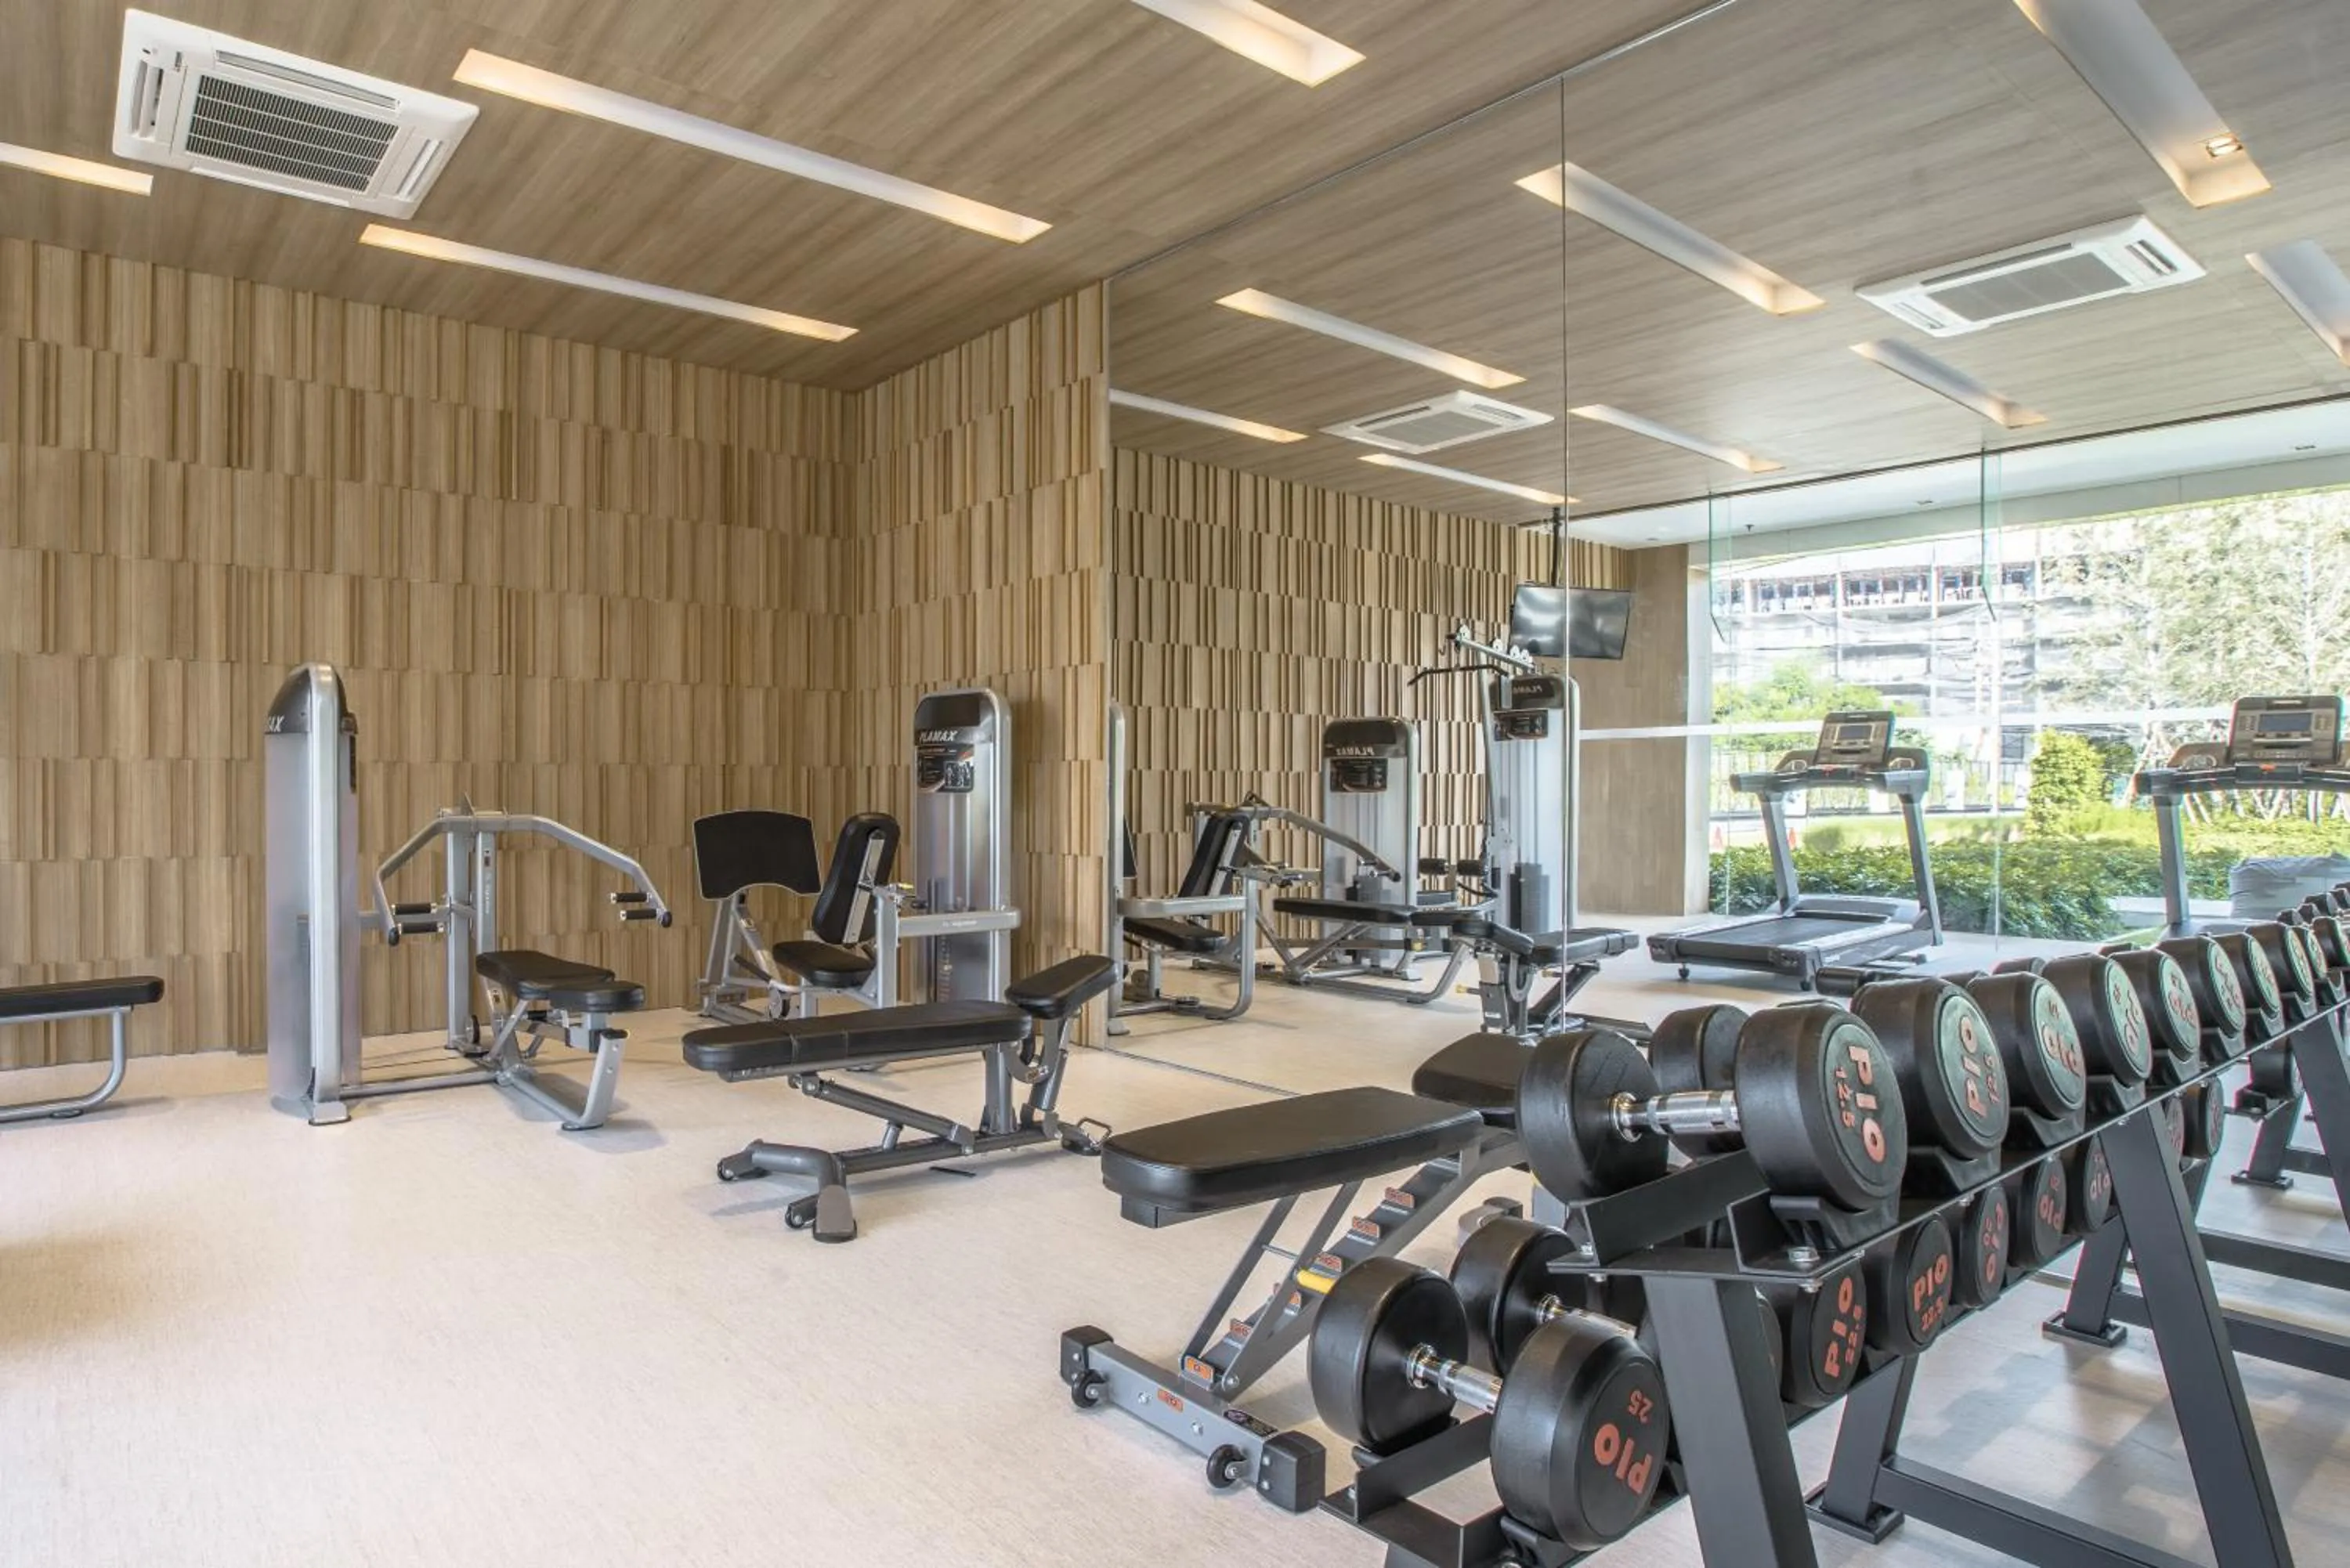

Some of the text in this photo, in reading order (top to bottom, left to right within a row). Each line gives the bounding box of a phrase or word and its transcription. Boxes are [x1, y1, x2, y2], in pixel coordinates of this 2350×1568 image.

[1960, 1016, 1987, 1118] PIO
[2042, 1025, 2081, 1078] PIO
[1835, 1067, 1856, 1128] 12.5
[1849, 1046, 1885, 1163] PIO
[1987, 1201, 2004, 1283] PIO
[2040, 1194, 2066, 1230] PIO
[1914, 1253, 1948, 1311] PIO
[1824, 1277, 1853, 1378] PIO
[1845, 1305, 1863, 1365] 22.5
[1921, 1296, 1944, 1331] 22.5
[1629, 1390, 1654, 1424] 25
[1594, 1422, 1653, 1494] PIO
